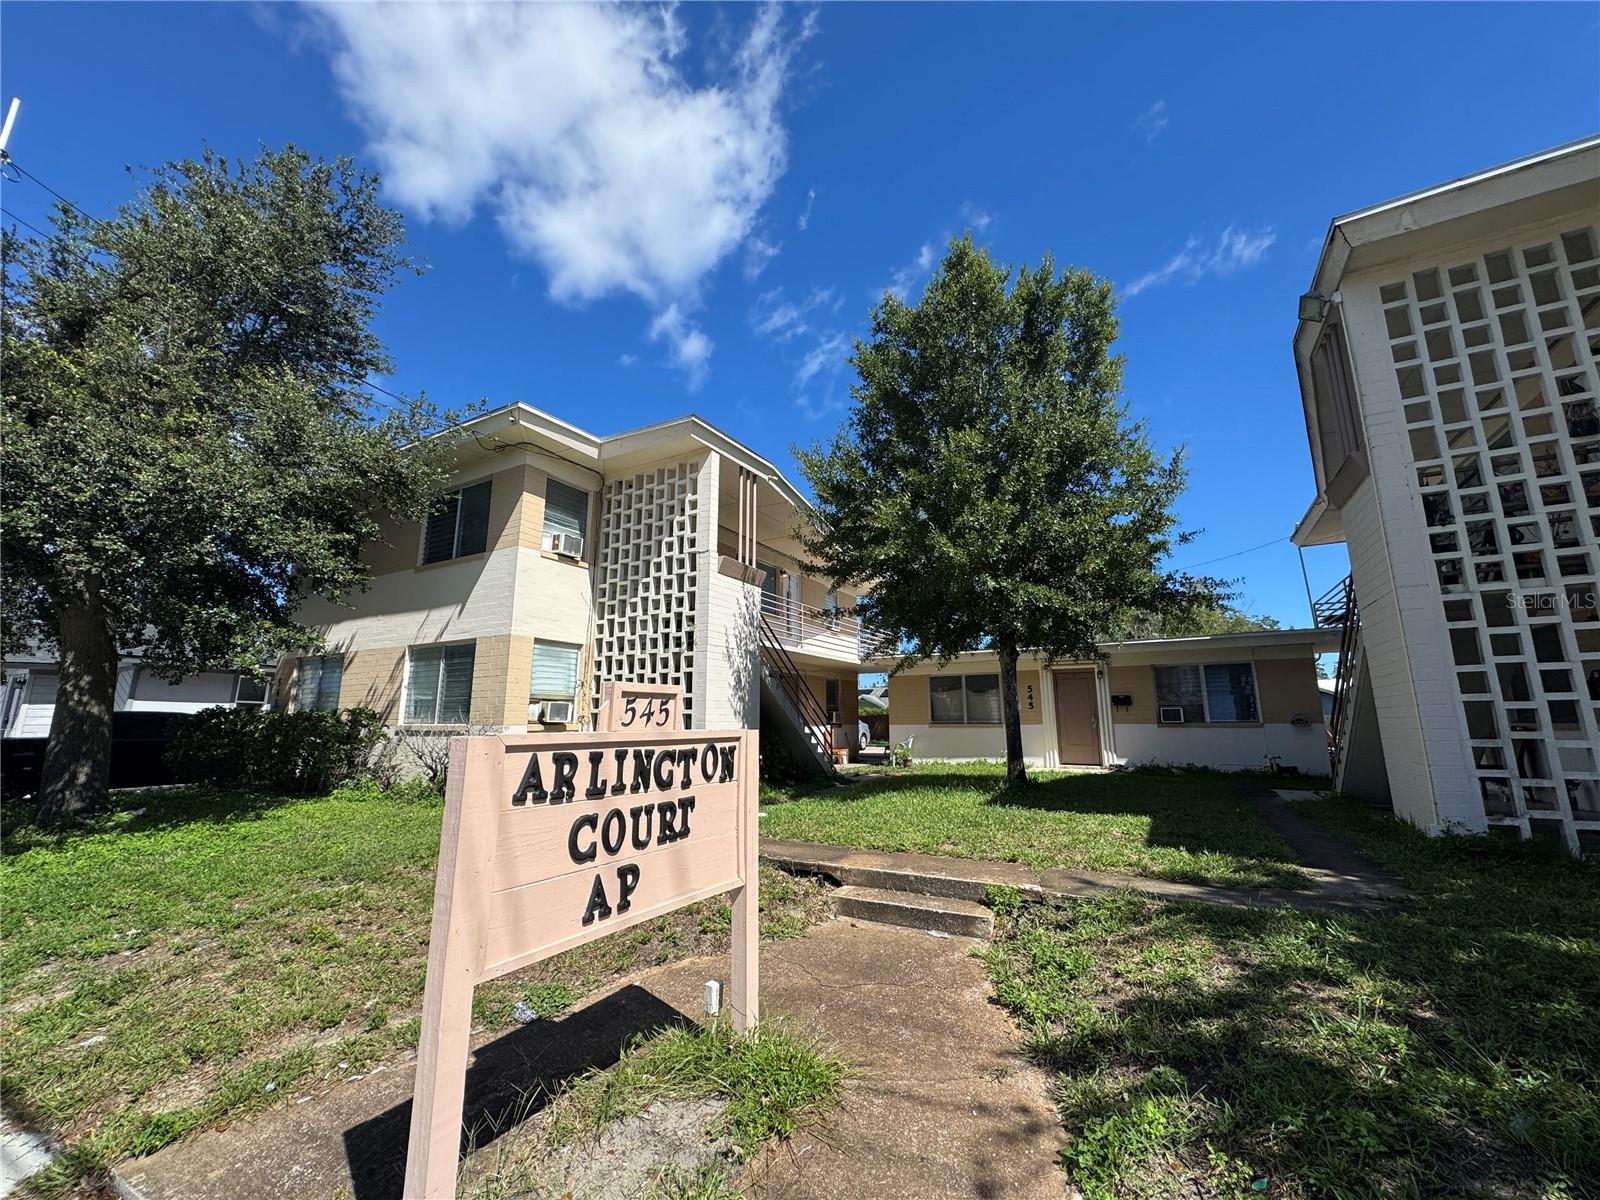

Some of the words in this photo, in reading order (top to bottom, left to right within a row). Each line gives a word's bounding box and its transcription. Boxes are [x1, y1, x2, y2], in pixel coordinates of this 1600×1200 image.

[621, 696, 669, 728] 545
[512, 743, 736, 806] ARLINGTON
[568, 796, 695, 864] COURT
[582, 863, 640, 927] AP
